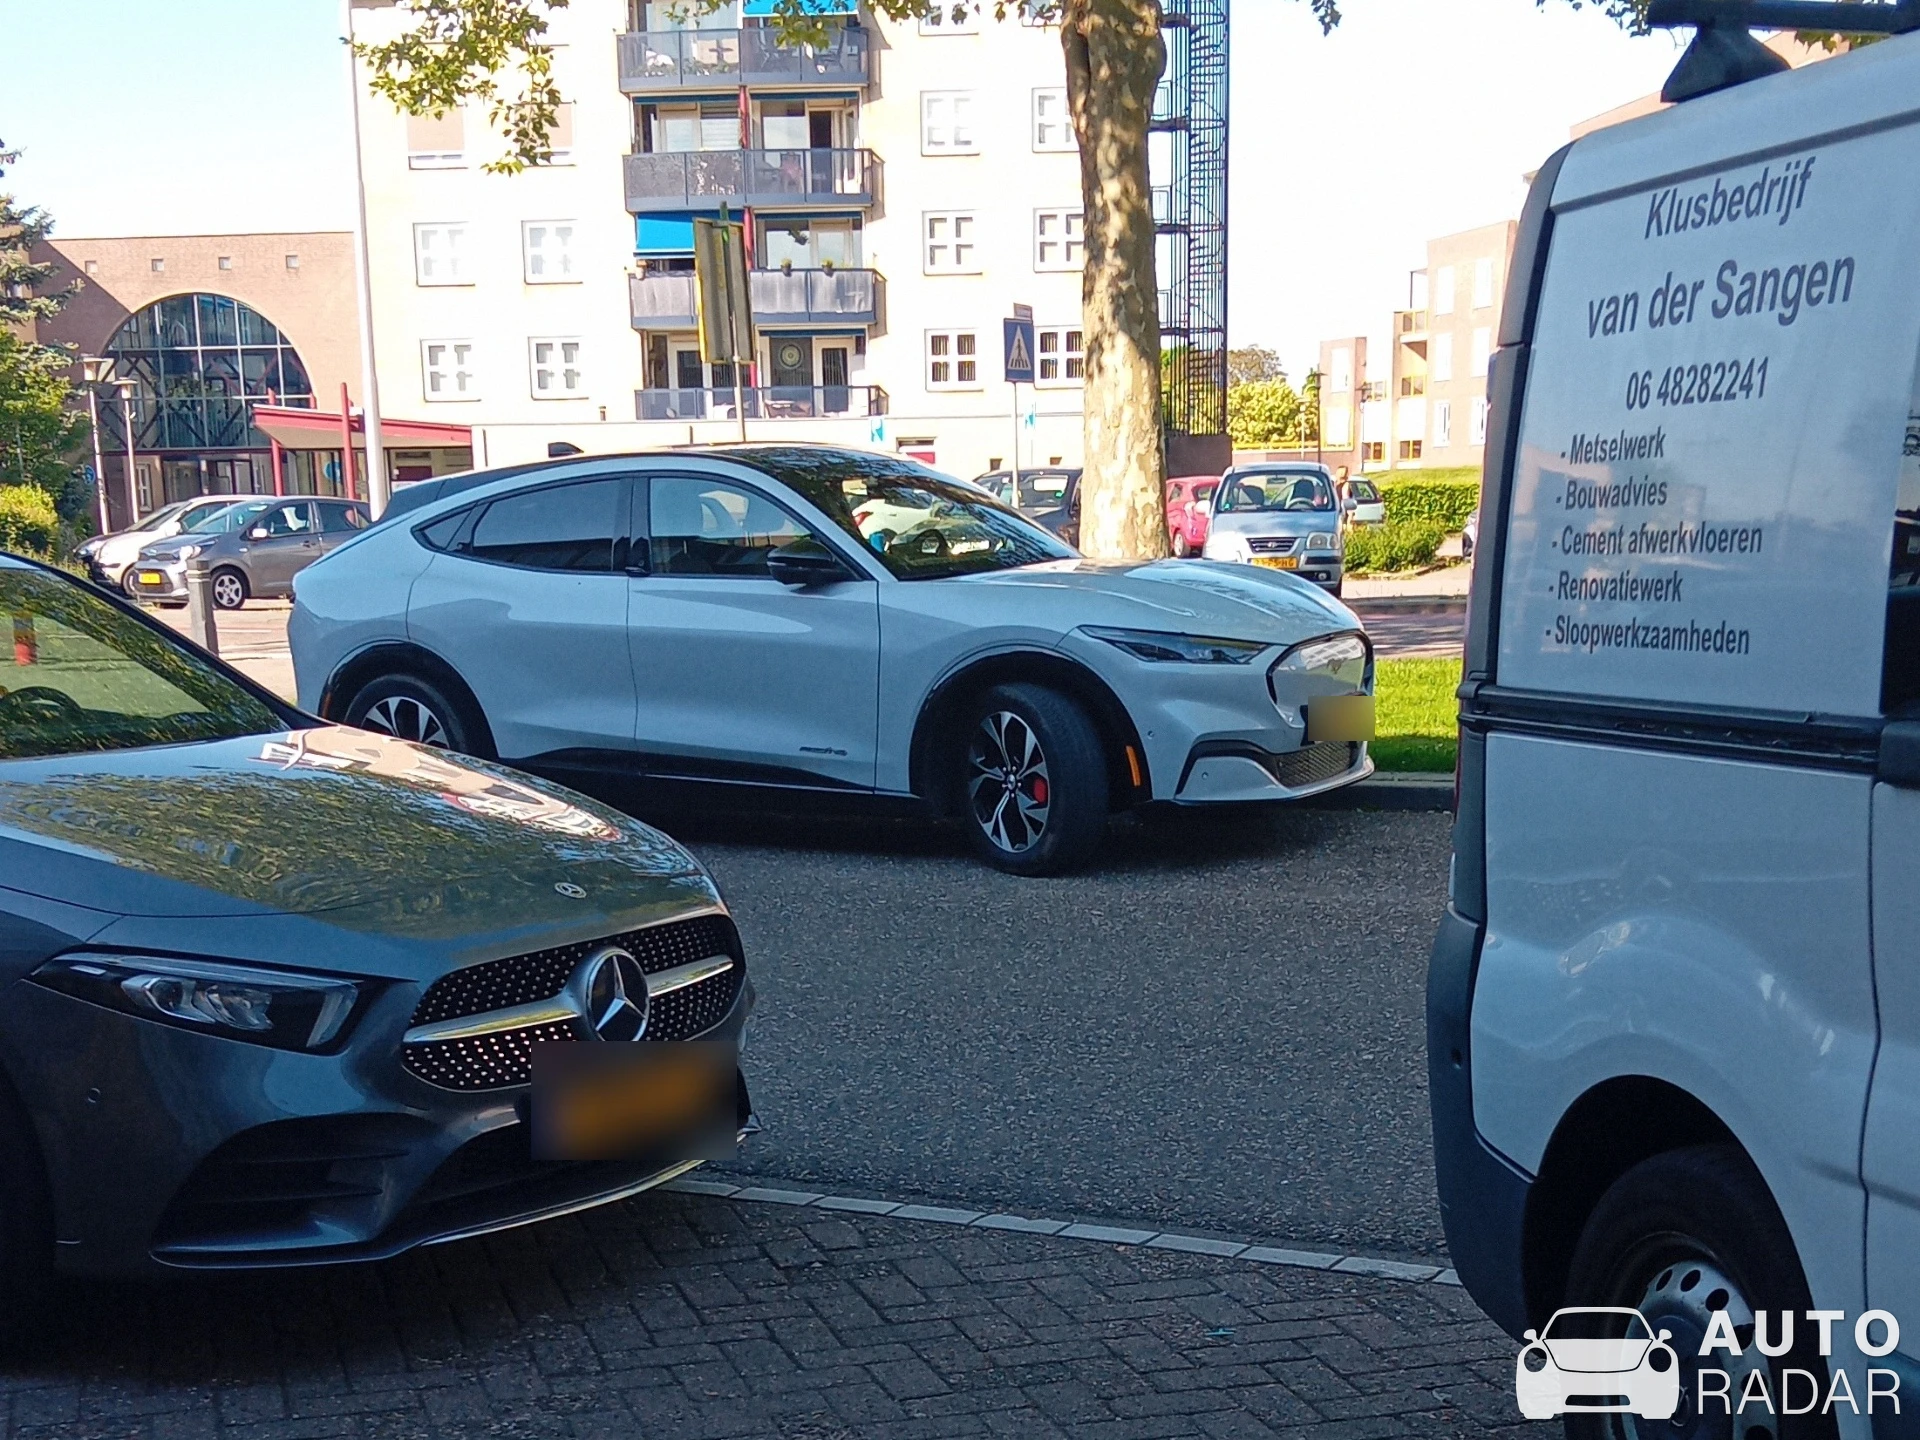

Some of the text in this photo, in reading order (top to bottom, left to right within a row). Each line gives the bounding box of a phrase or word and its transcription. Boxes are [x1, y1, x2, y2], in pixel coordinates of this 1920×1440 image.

[1645, 156, 1816, 239] Klusbedrijf
[1588, 256, 1855, 339] van der Sangen
[1626, 356, 1769, 411] 06 48282241
[1570, 425, 1666, 465] Metselwerk
[1565, 474, 1667, 510] Bouwadvies
[1561, 521, 1762, 556] Cement afwerkvloeren
[1558, 569, 1683, 601] Renovatiewerk
[1555, 614, 1749, 654] Sloopwerkzaamheden
